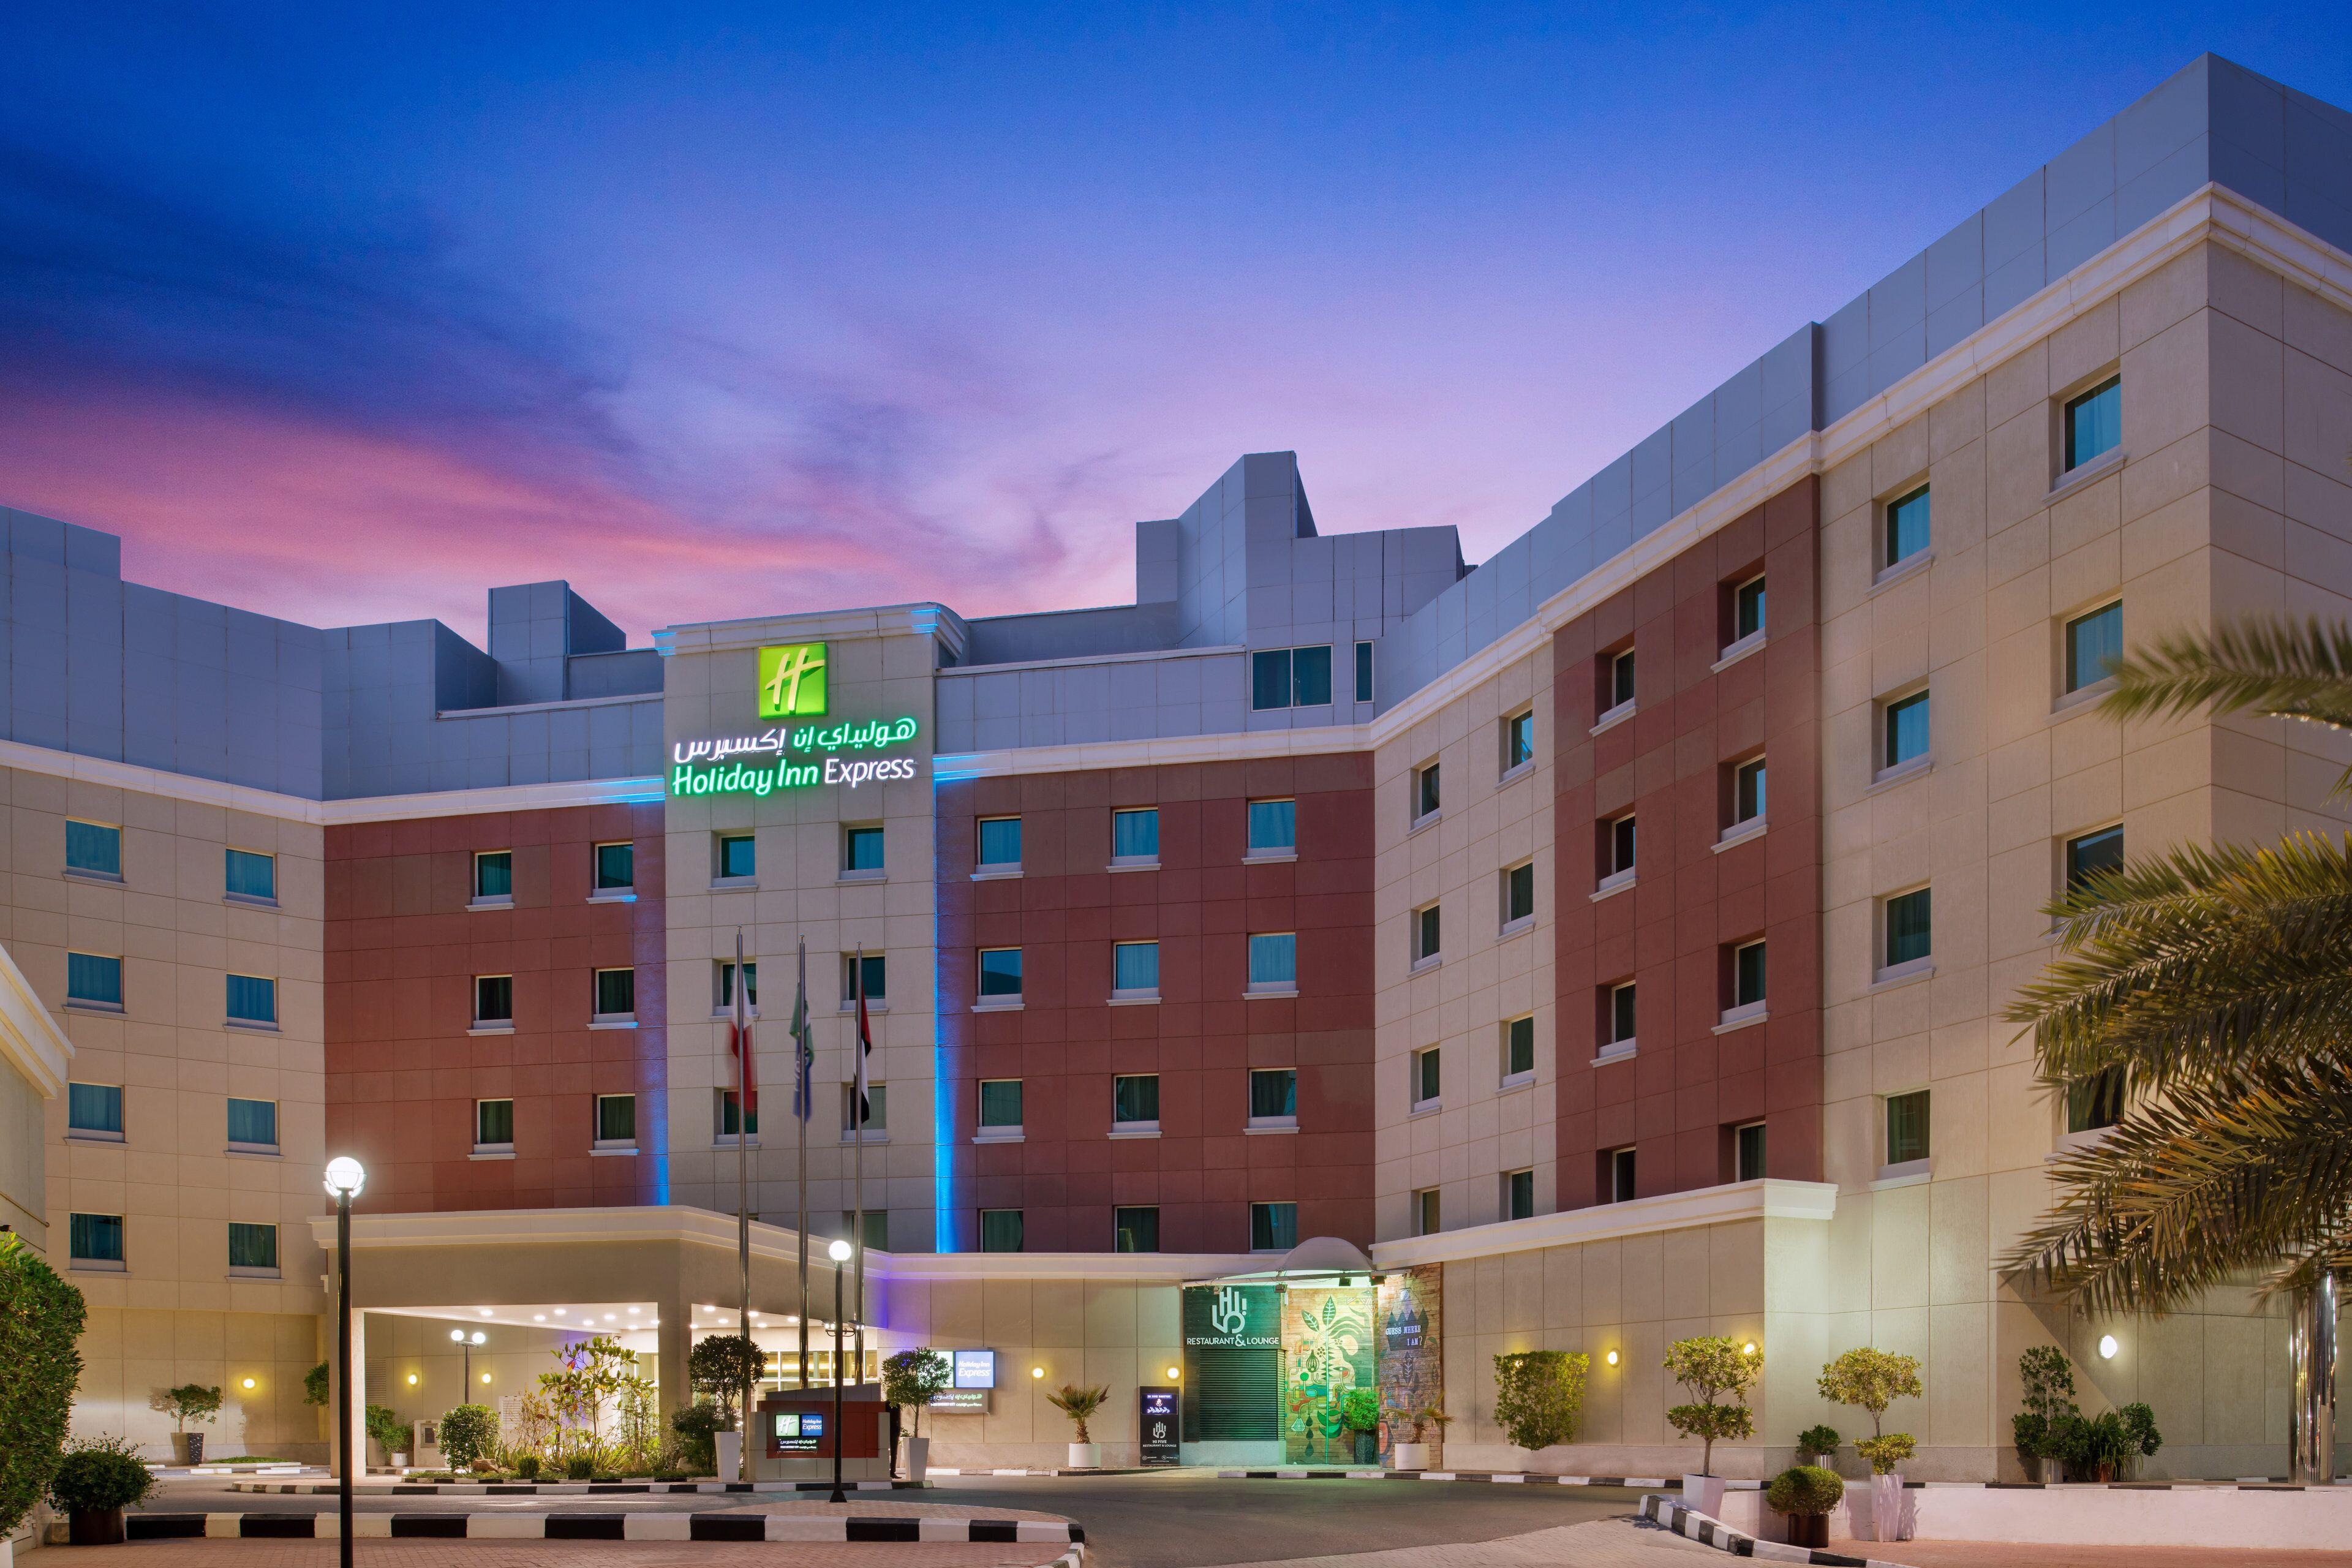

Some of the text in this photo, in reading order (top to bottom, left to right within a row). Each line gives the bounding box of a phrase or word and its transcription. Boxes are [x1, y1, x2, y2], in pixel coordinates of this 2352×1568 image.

[675, 718, 916, 763] هوليداي إن إكسبرس
[673, 758, 915, 796] Holiday Inn Express
[1385, 1325, 1421, 1335] GUESS WHERE
[1235, 1333, 1246, 1347] &
[959, 1368, 991, 1378] Express
